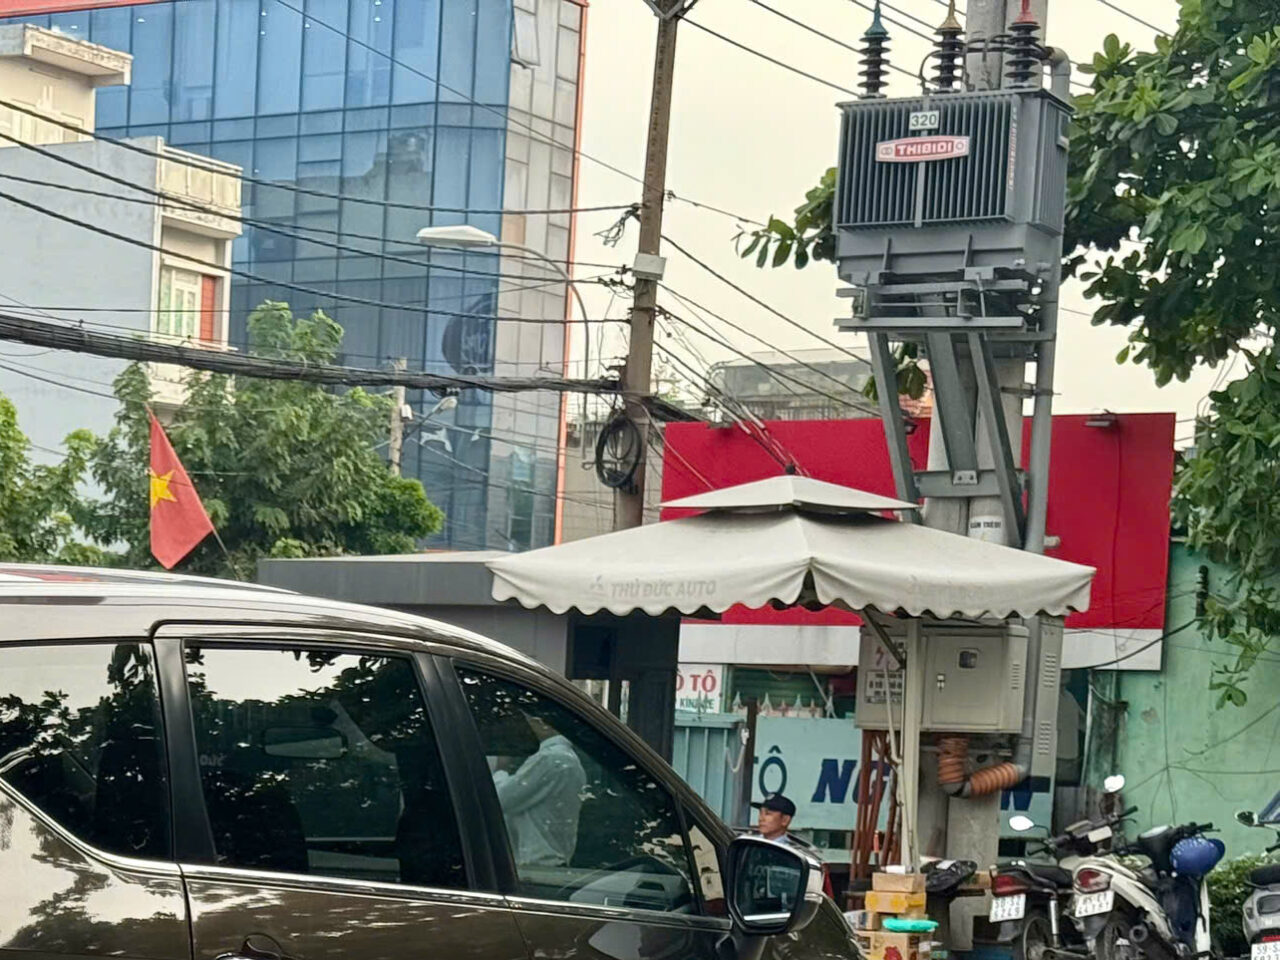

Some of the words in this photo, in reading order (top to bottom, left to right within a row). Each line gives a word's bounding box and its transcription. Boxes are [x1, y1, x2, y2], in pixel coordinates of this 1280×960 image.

[911, 113, 937, 127] 320
[897, 142, 953, 155] THIBIDI
[676, 579, 718, 596] AUTO
[690, 669, 717, 693] TÔ
